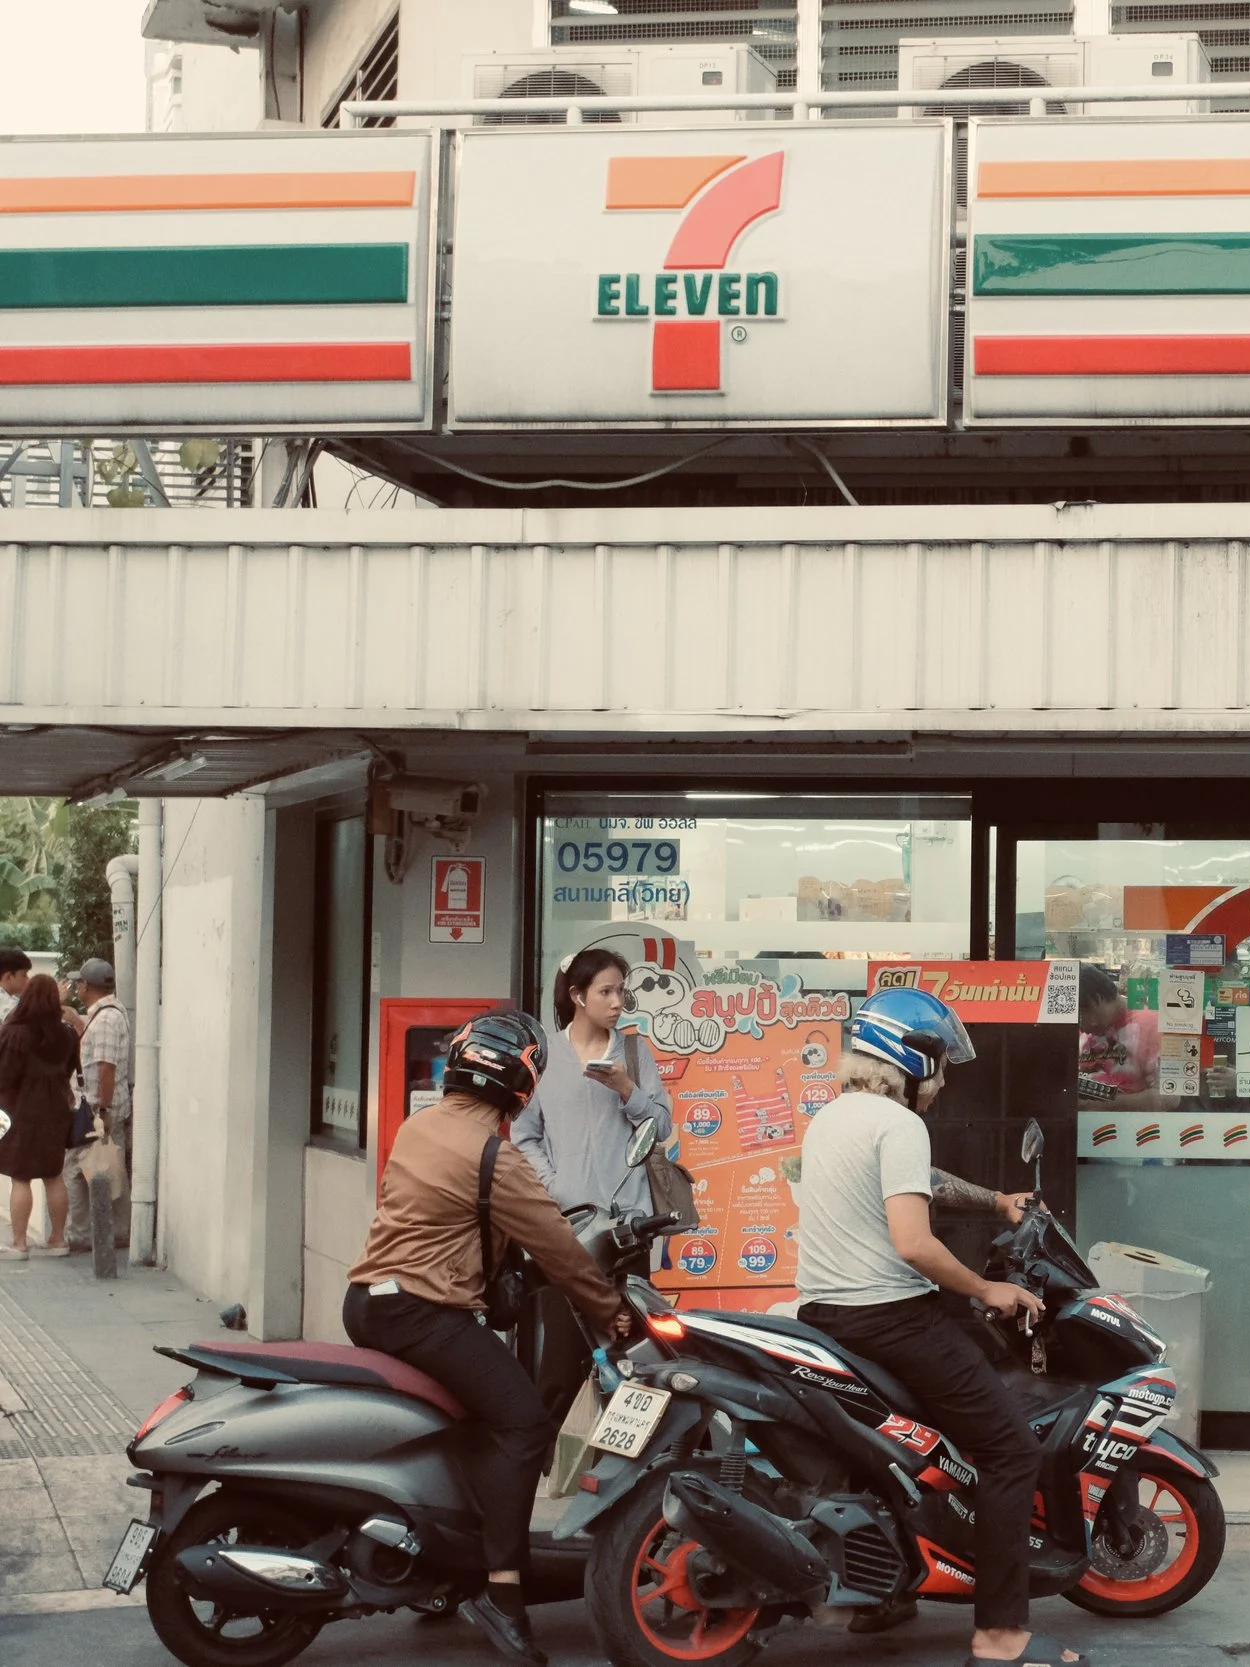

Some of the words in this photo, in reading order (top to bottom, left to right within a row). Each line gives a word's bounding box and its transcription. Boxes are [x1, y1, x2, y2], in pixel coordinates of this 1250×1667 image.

[557, 841, 678, 873] 05979
[690, 982, 778, 1028] สนูปปี้
[1090, 1308, 1121, 1328] MOTUL
[599, 1427, 636, 1450] 2628
[875, 1413, 941, 1457] 29
[1082, 1431, 1138, 1461] tyco
[939, 1455, 973, 1487] YAMAHA
